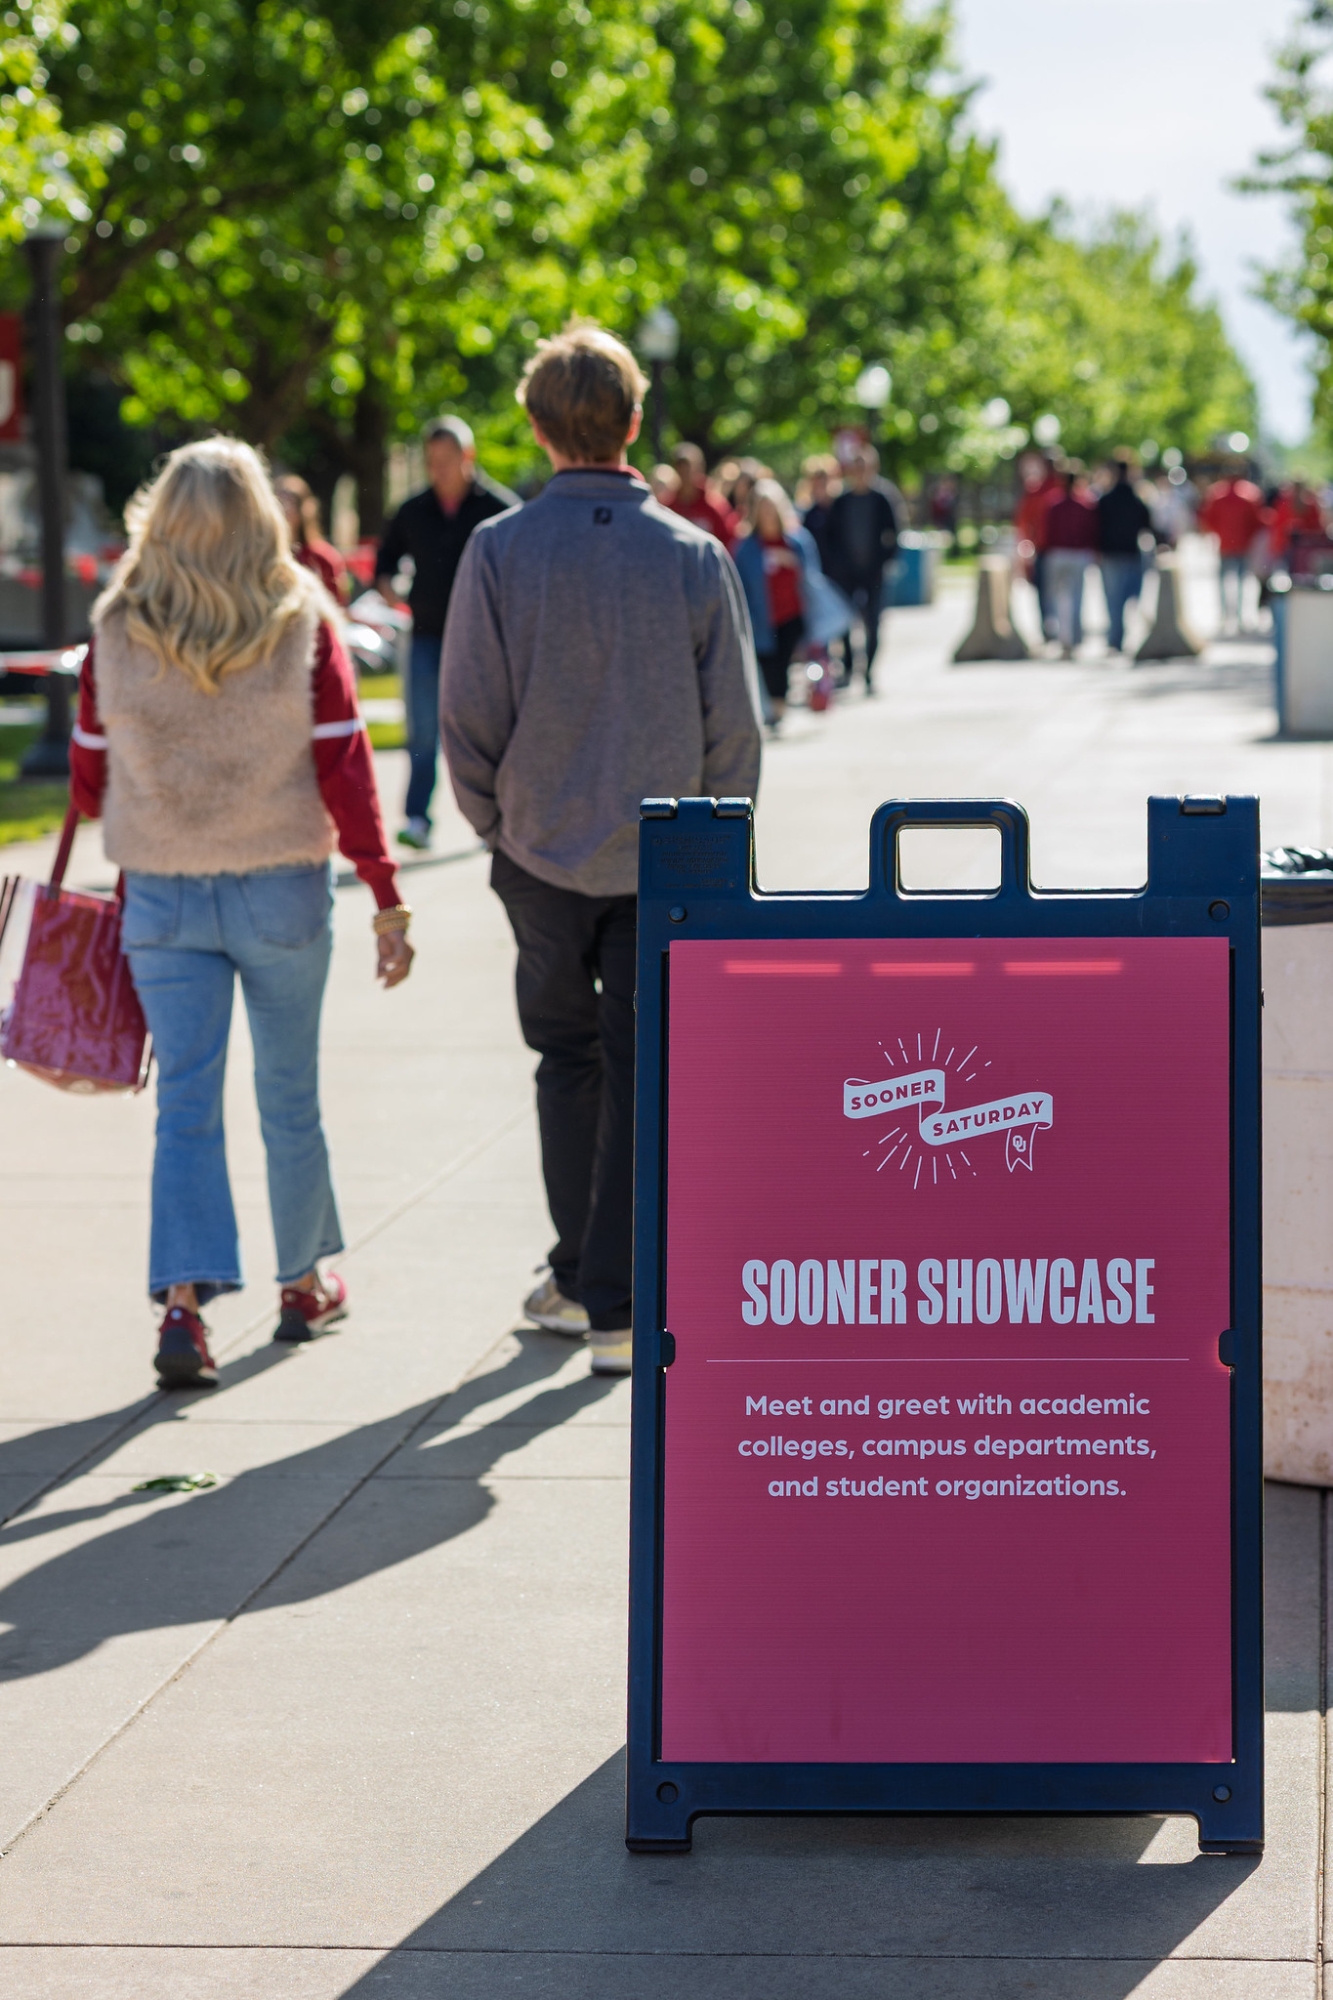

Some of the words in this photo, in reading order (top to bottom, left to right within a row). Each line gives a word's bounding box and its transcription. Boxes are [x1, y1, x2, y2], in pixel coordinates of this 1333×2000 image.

[851, 1079, 936, 1111] SOONER
[932, 1100, 1044, 1137] SATURDAY
[741, 1259, 907, 1326] SOONER
[917, 1258, 1156, 1325] SHOWCASE
[745, 1395, 813, 1416] Meet
[819, 1394, 870, 1416] and
[877, 1395, 950, 1420] greet
[956, 1392, 1012, 1415] with
[1019, 1392, 1150, 1415] academic
[737, 1435, 855, 1461] colleges,
[861, 1439, 967, 1460] campus
[973, 1434, 1157, 1460] departments,
[767, 1476, 819, 1497] and
[825, 1475, 929, 1497] student
[935, 1473, 1127, 1500] organizations.
